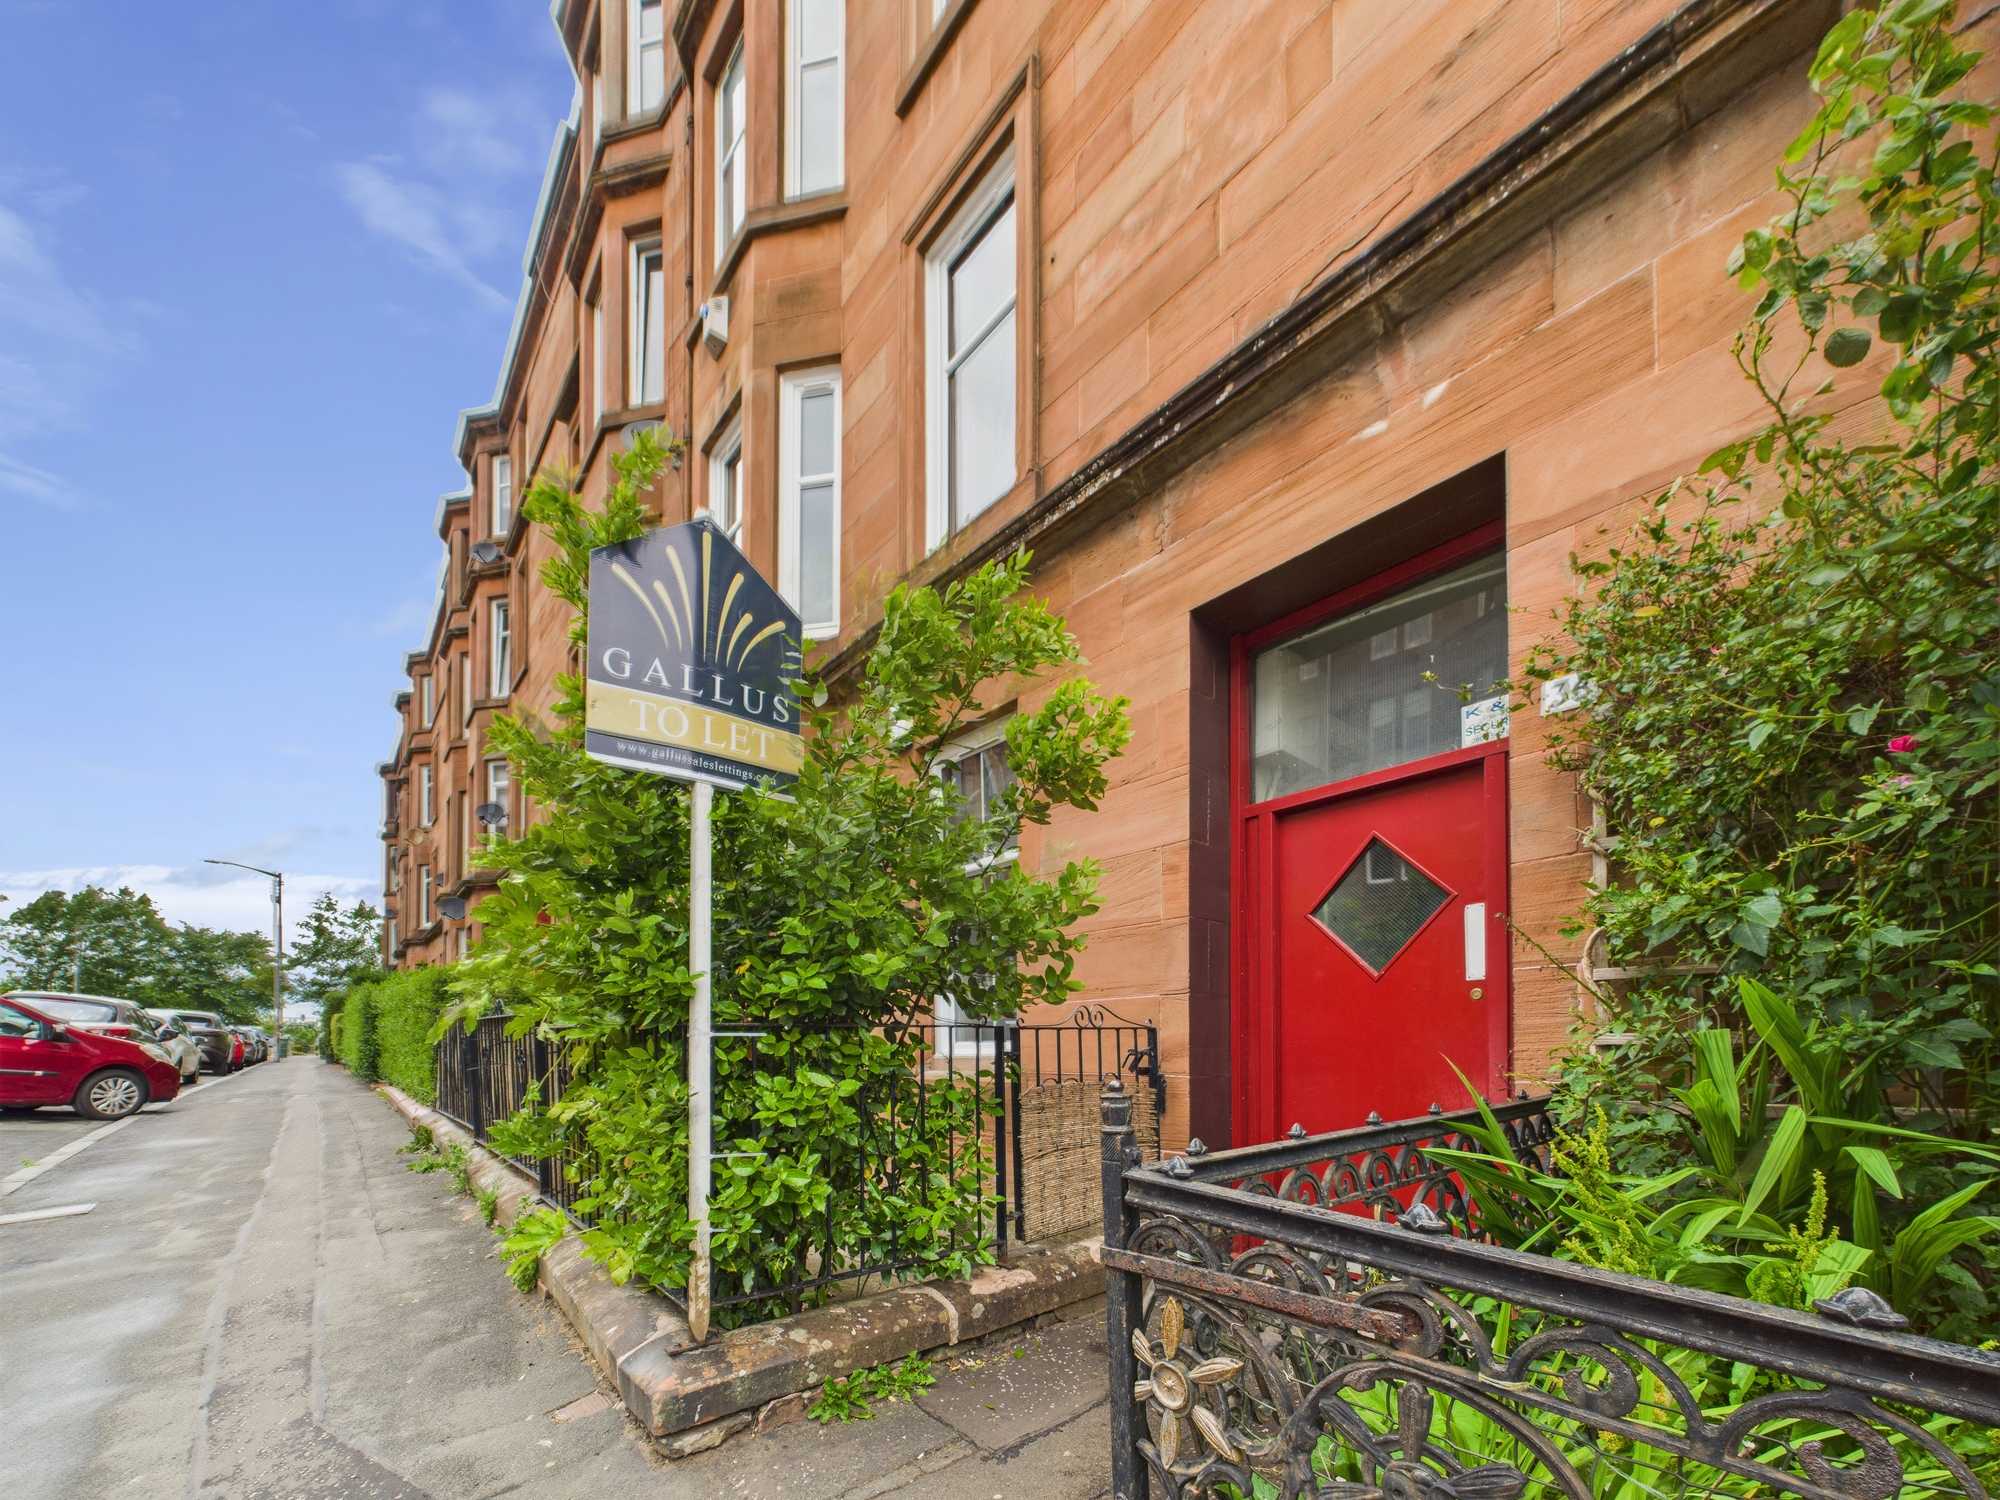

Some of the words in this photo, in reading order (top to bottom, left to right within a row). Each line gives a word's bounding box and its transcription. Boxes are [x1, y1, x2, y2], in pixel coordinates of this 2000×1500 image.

[603, 647, 790, 723] GALLUS
[629, 698, 689, 738] TO
[703, 715, 776, 760] LET
[616, 741, 777, 786] www.gallussaleslettings.cm
